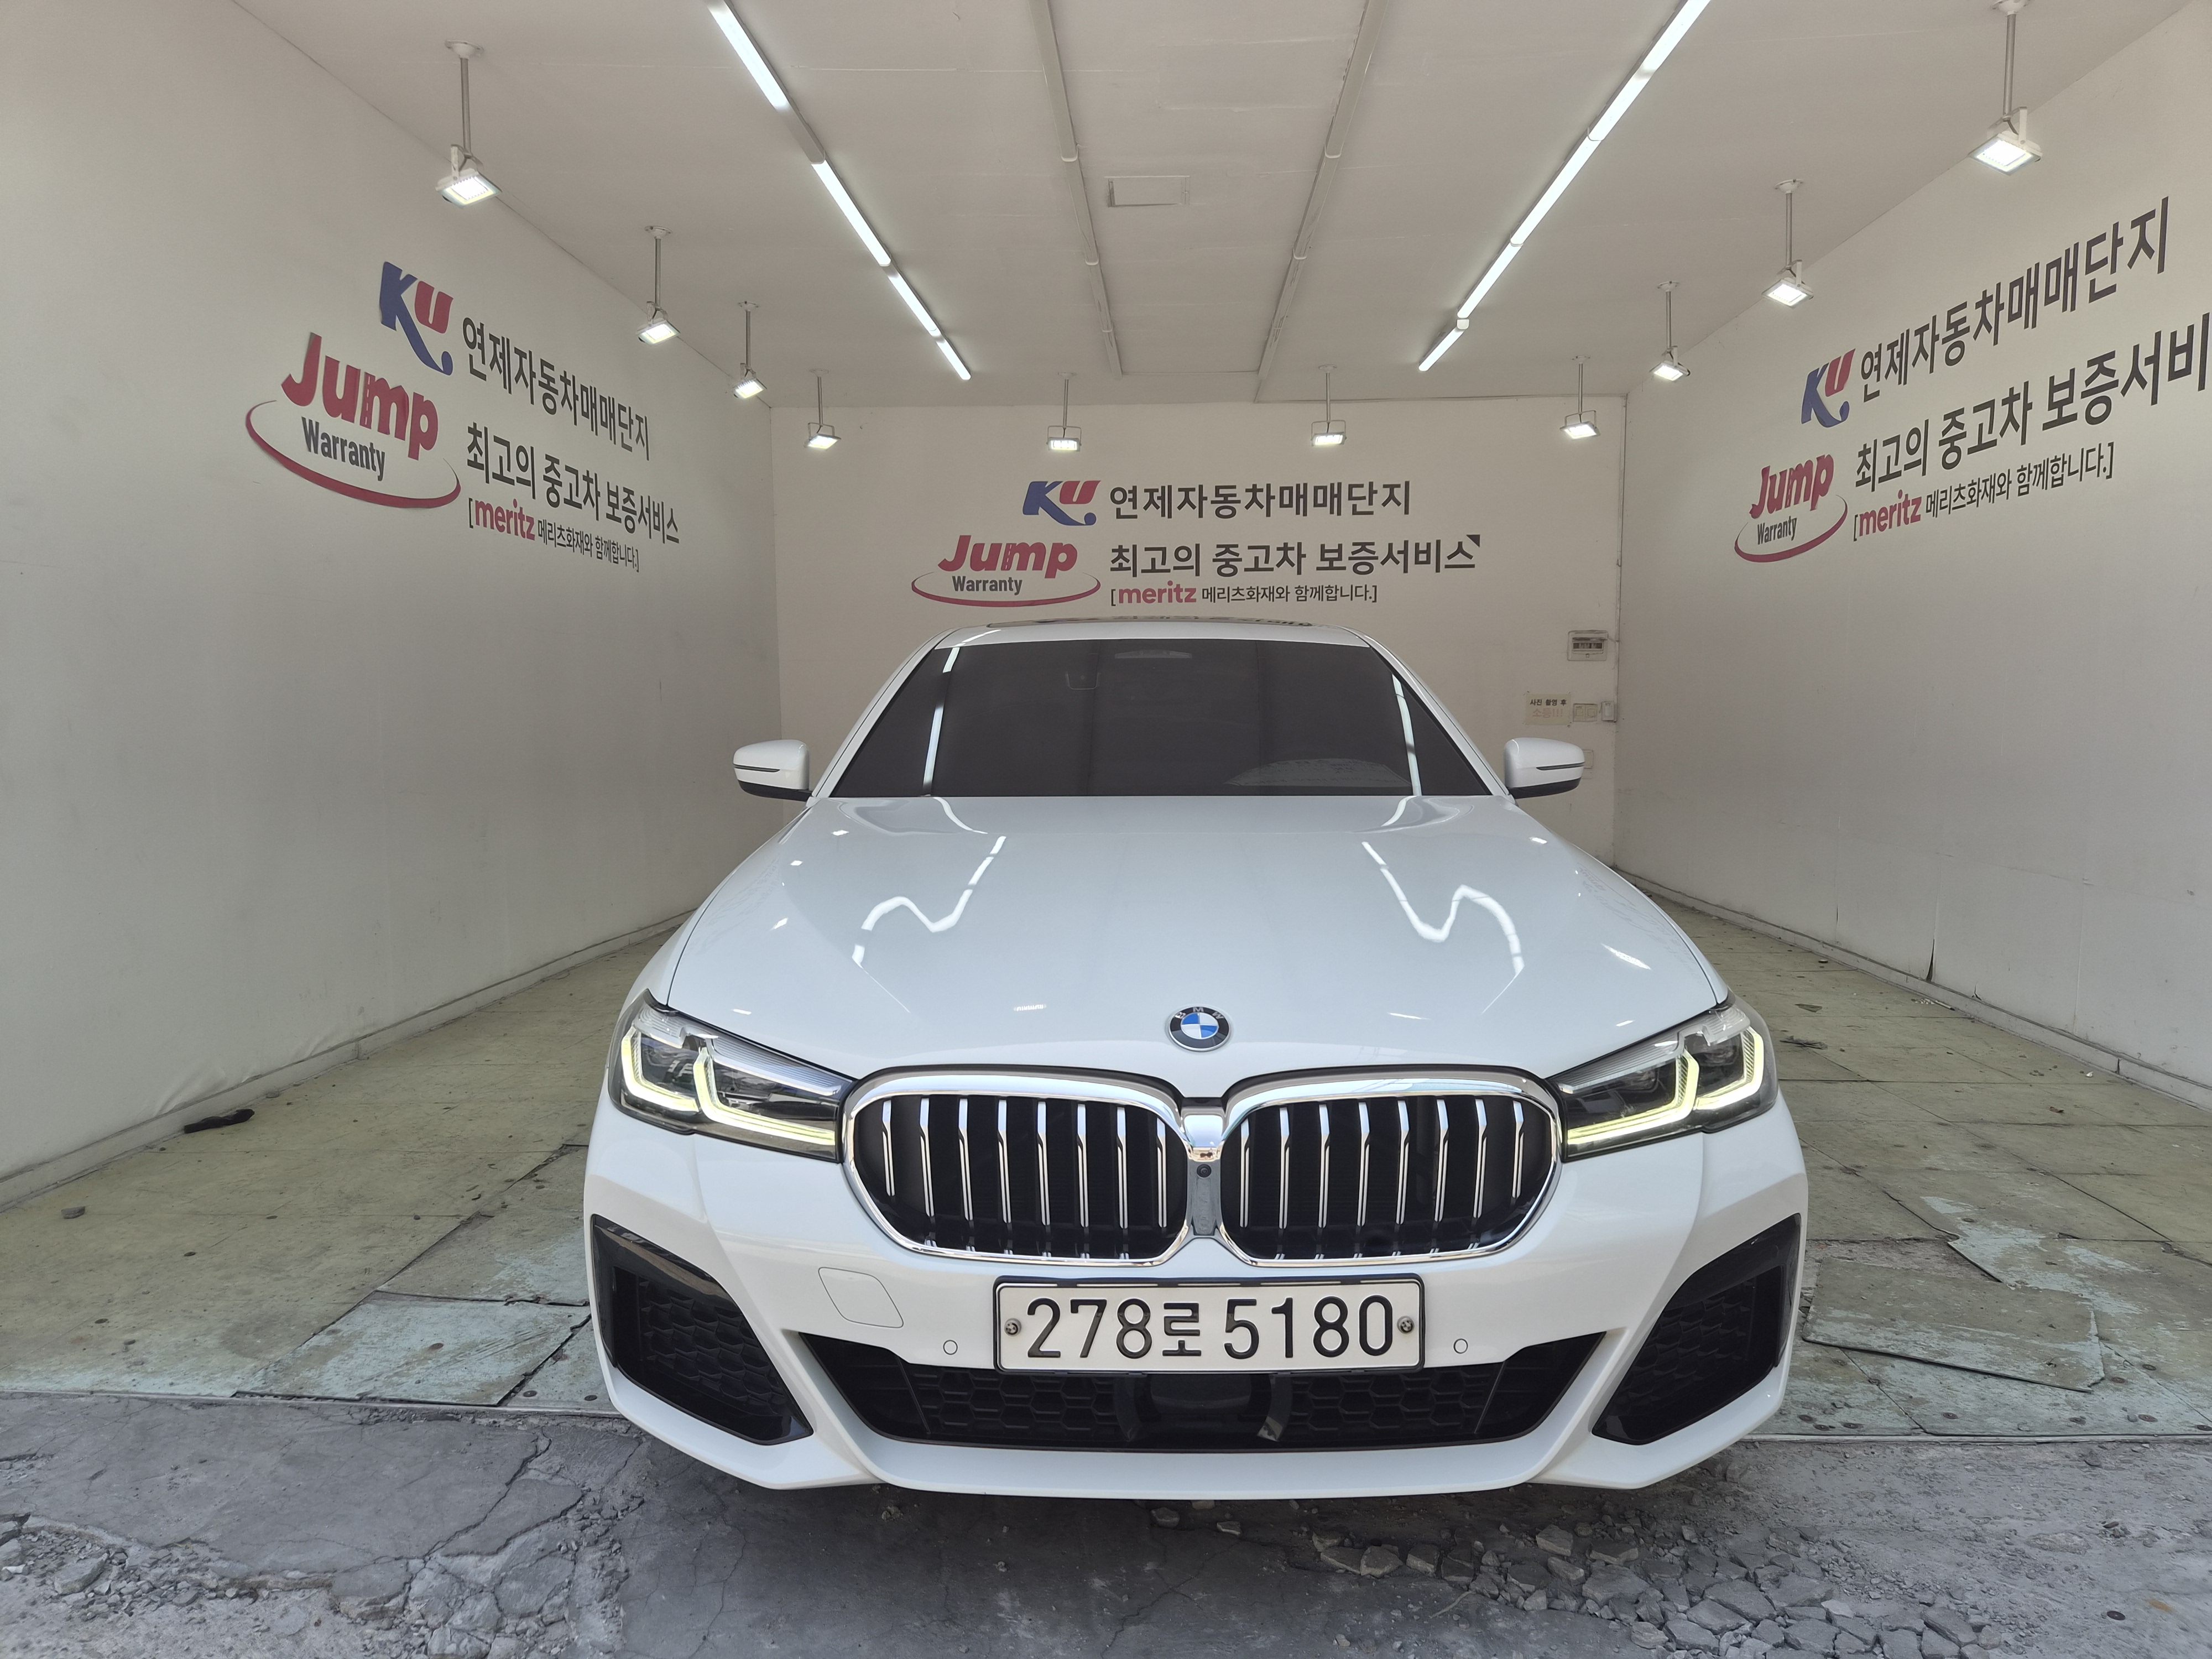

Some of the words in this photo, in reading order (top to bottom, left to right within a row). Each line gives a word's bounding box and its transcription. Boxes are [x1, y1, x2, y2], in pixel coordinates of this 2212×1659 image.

[1860, 196, 2169, 403] 연제자동차매매단지
[281, 332, 439, 460] Jump
[463, 317, 650, 461] 연제자동차매매단지
[301, 416, 386, 482] Warranty
[1855, 419, 1929, 493] 최고의
[1939, 380, 2033, 470] 중고차
[467, 422, 536, 500] 최고의
[543, 453, 601, 521] 중고차
[606, 481, 680, 544] 보증서비스
[1109, 481, 1410, 519] 연제자동차매매단지
[1749, 453, 1834, 519] Jump
[1926, 468, 2012, 518] 메리츠화재와
[2016, 441, 2115, 497] 함께합니다.]
[538, 519, 593, 557] 메리츠화재와
[595, 535, 640, 573] 함께합니다.]
[937, 535, 1078, 579] Jump
[1109, 543, 1201, 578] 최고의
[1212, 542, 1307, 577] 중고차
[1316, 539, 1475, 575] 보증서비스
[1757, 515, 1797, 545] Warranty
[952, 576, 1022, 596] Warranty
[1202, 585, 1290, 603] 메리츠화재와
[1295, 584, 1378, 603] 함께합니다.]
[1174, 1006, 1223, 1019] BMW
[1026, 1297, 1202, 1360] 278로
[1224, 1295, 1394, 1360] 5180
